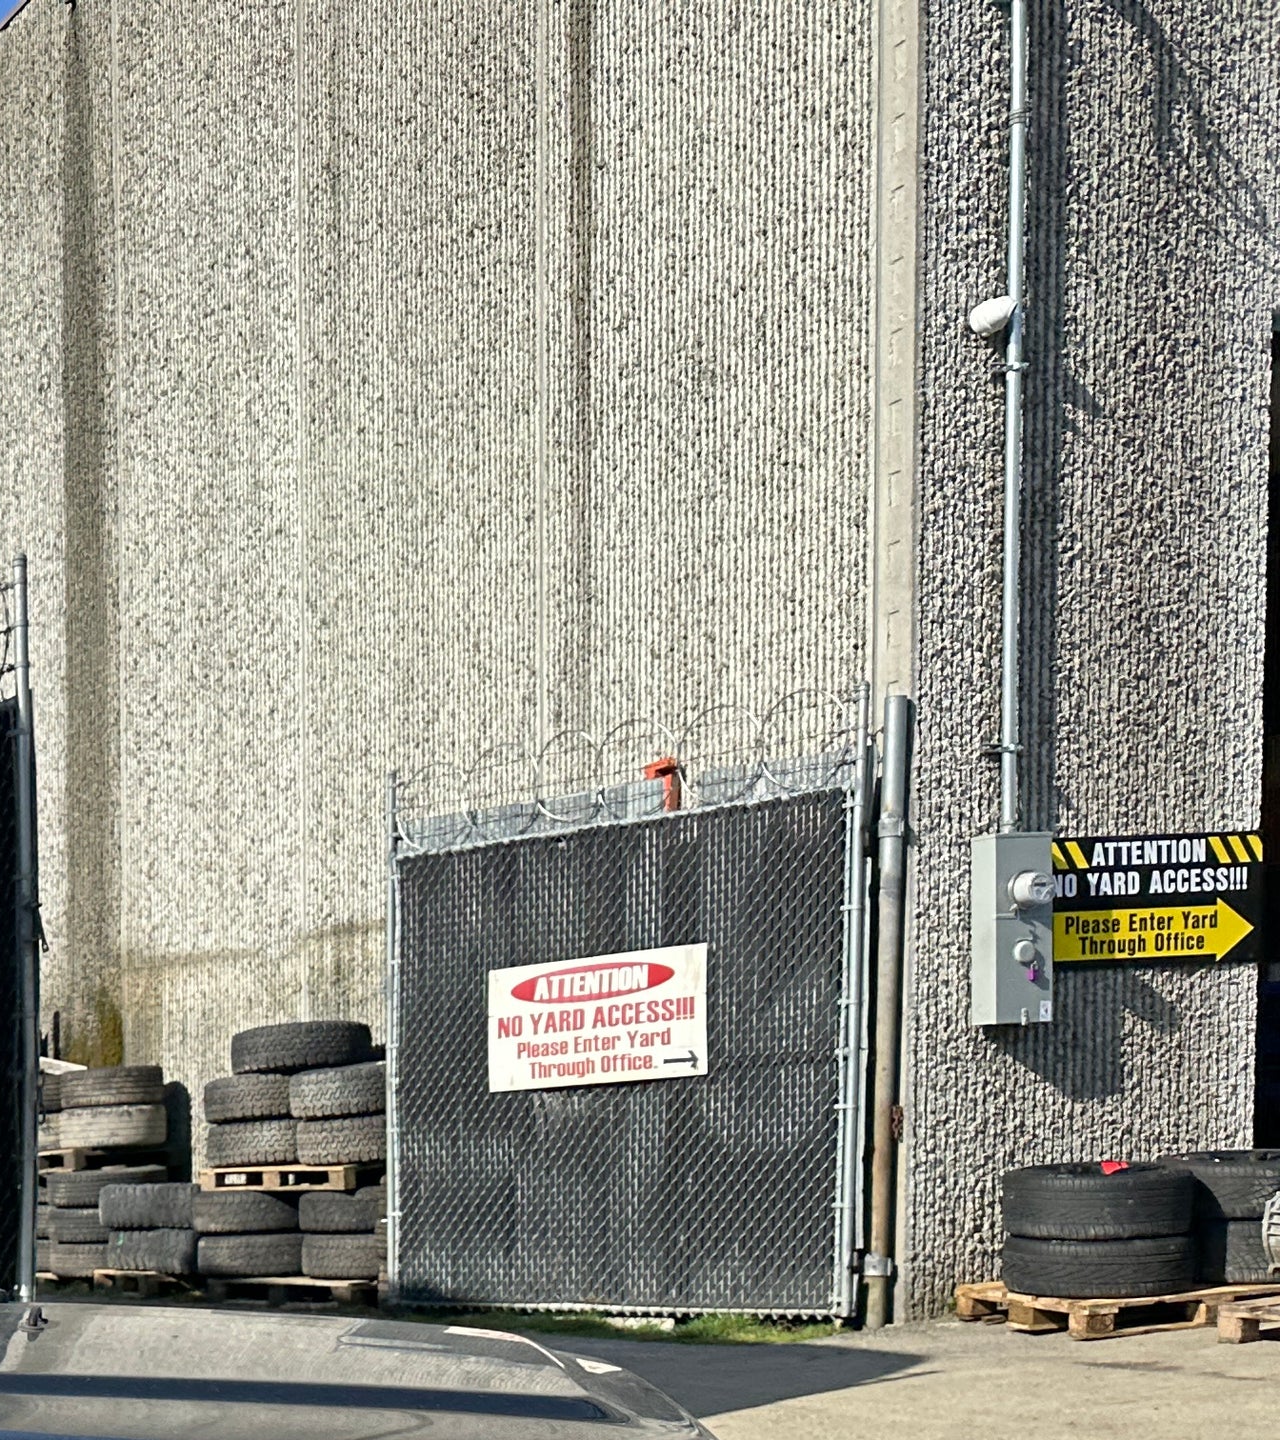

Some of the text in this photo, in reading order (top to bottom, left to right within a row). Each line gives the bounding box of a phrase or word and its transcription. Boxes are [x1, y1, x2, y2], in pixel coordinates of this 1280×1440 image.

[1091, 838, 1207, 867] ATTENTION
[1087, 870, 1140, 897] YARD
[1149, 866, 1248, 894] ACCESS!!!
[1065, 910, 1219, 936] Please Enter Yard
[1078, 933, 1205, 956] Through Office
[533, 964, 649, 1001] ATTENTION
[497, 996, 696, 1039] NO YARD ACCESS!!!
[517, 1027, 672, 1060] Please Enter Yard
[529, 1056, 598, 1080] Through
